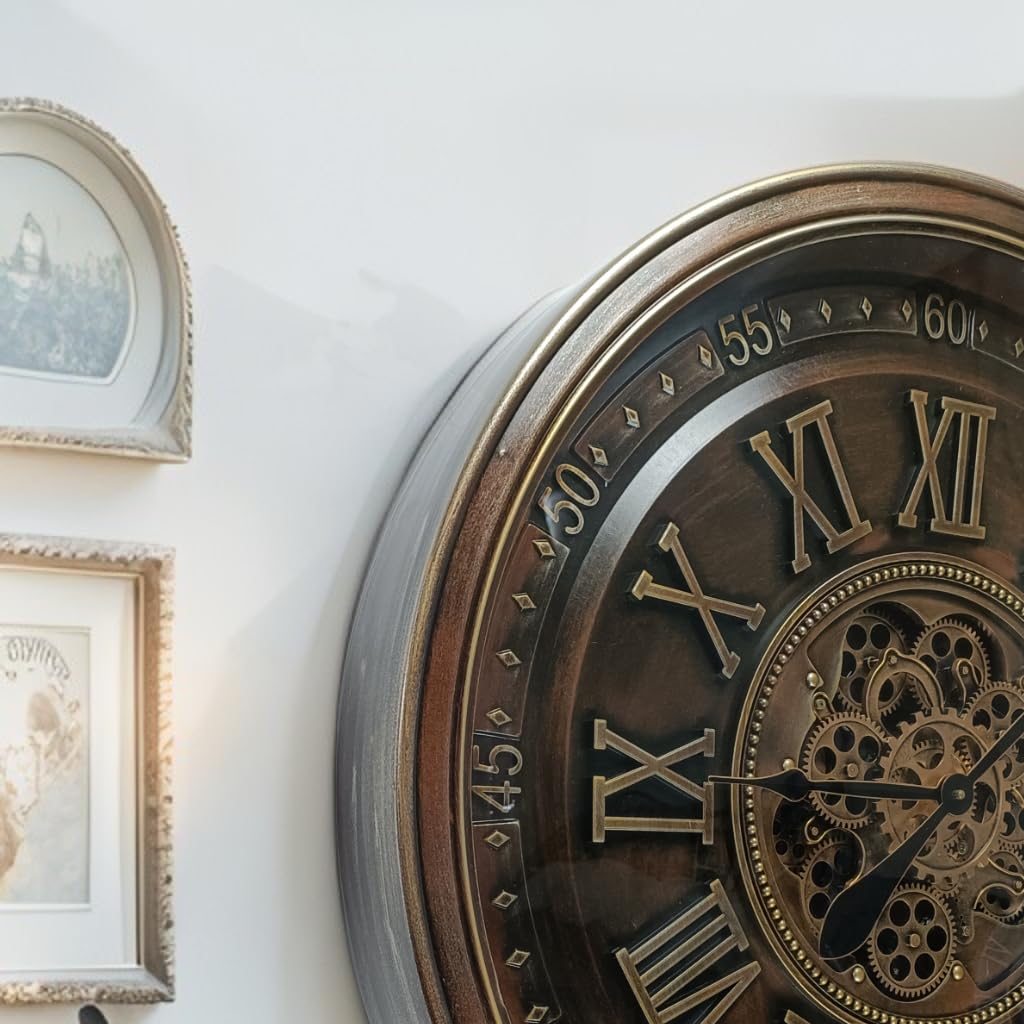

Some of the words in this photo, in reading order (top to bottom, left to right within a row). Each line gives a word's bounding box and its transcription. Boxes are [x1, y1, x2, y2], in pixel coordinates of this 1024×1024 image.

[718, 304, 774, 366] 55
[924, 294, 967, 344] 60
[540, 463, 600, 535] 50
[750, 400, 873, 574] XI
[898, 389, 997, 539] XII
[632, 522, 766, 678] X
[472, 744, 523, 811] 45
[592, 719, 715, 845] IX
